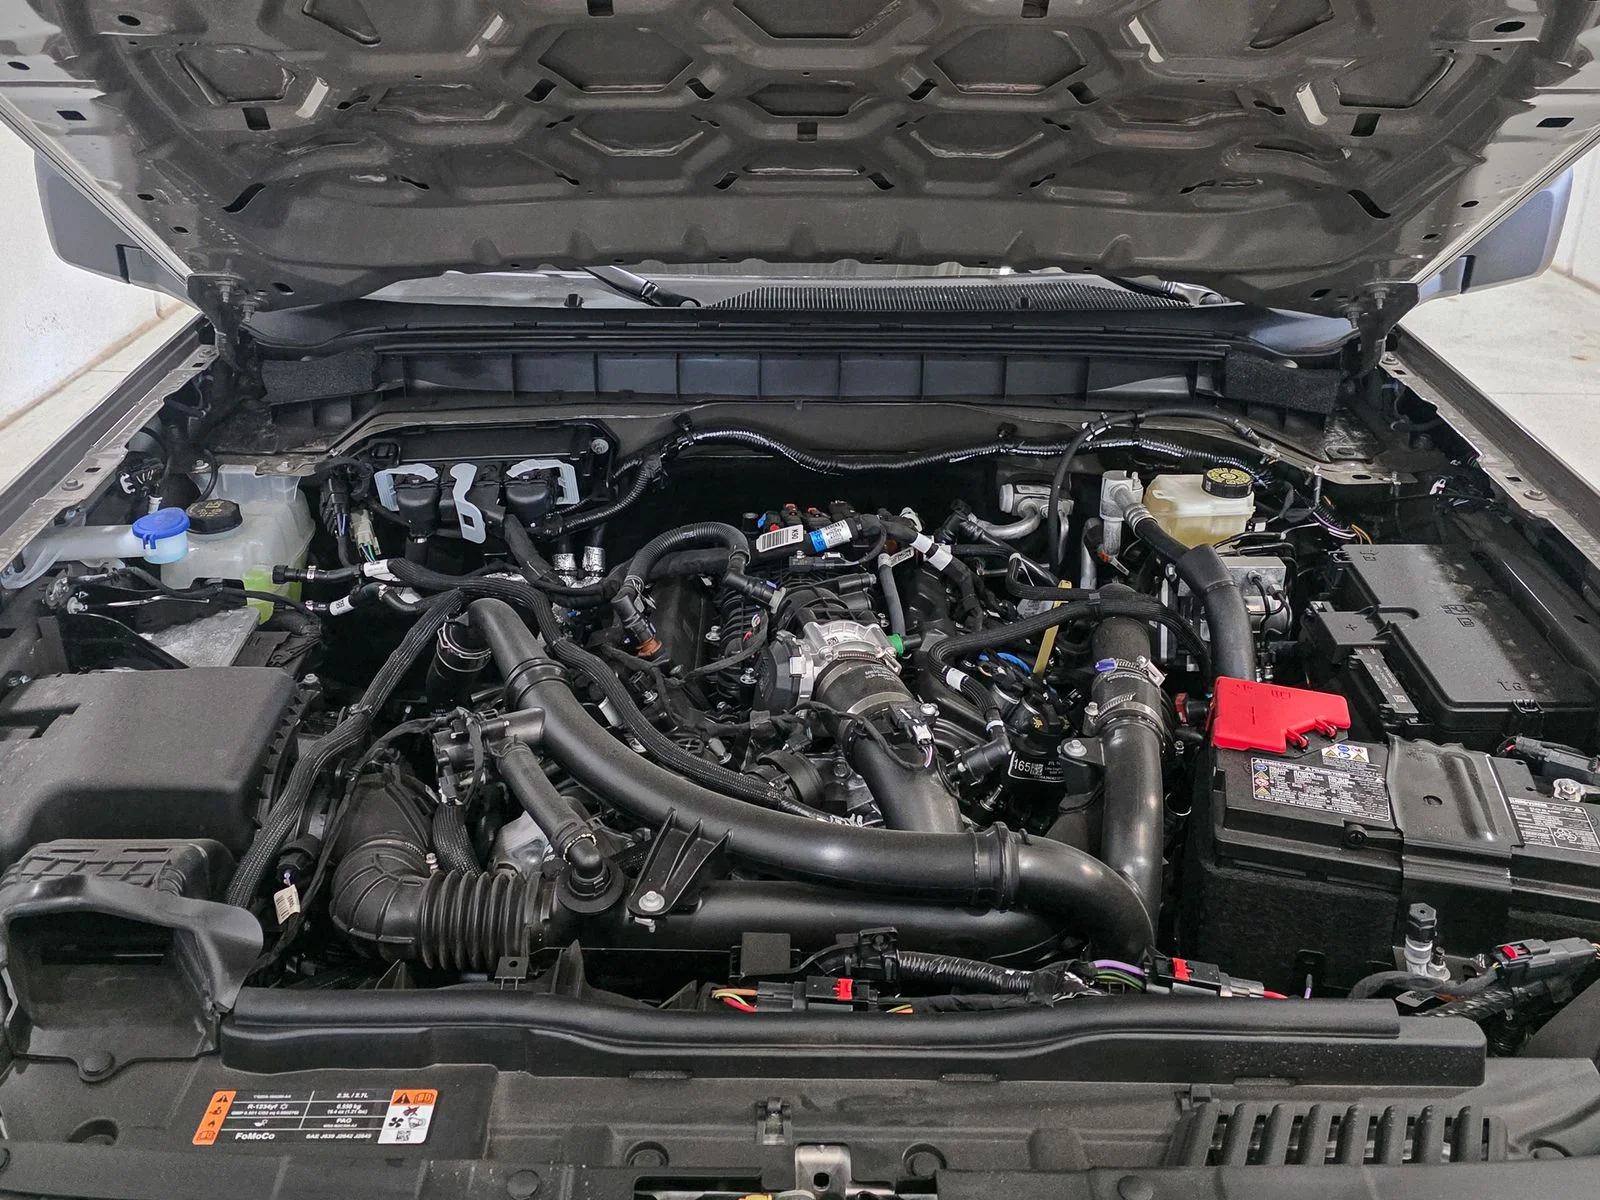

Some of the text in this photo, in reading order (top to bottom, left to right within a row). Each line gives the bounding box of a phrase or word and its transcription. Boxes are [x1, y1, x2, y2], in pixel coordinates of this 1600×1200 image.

[1014, 758, 1031, 772] 165
[247, 1103, 278, 1111] R-1234yf
[353, 1103, 362, 1111] kg
[234, 1132, 276, 1141] FoMoCo
